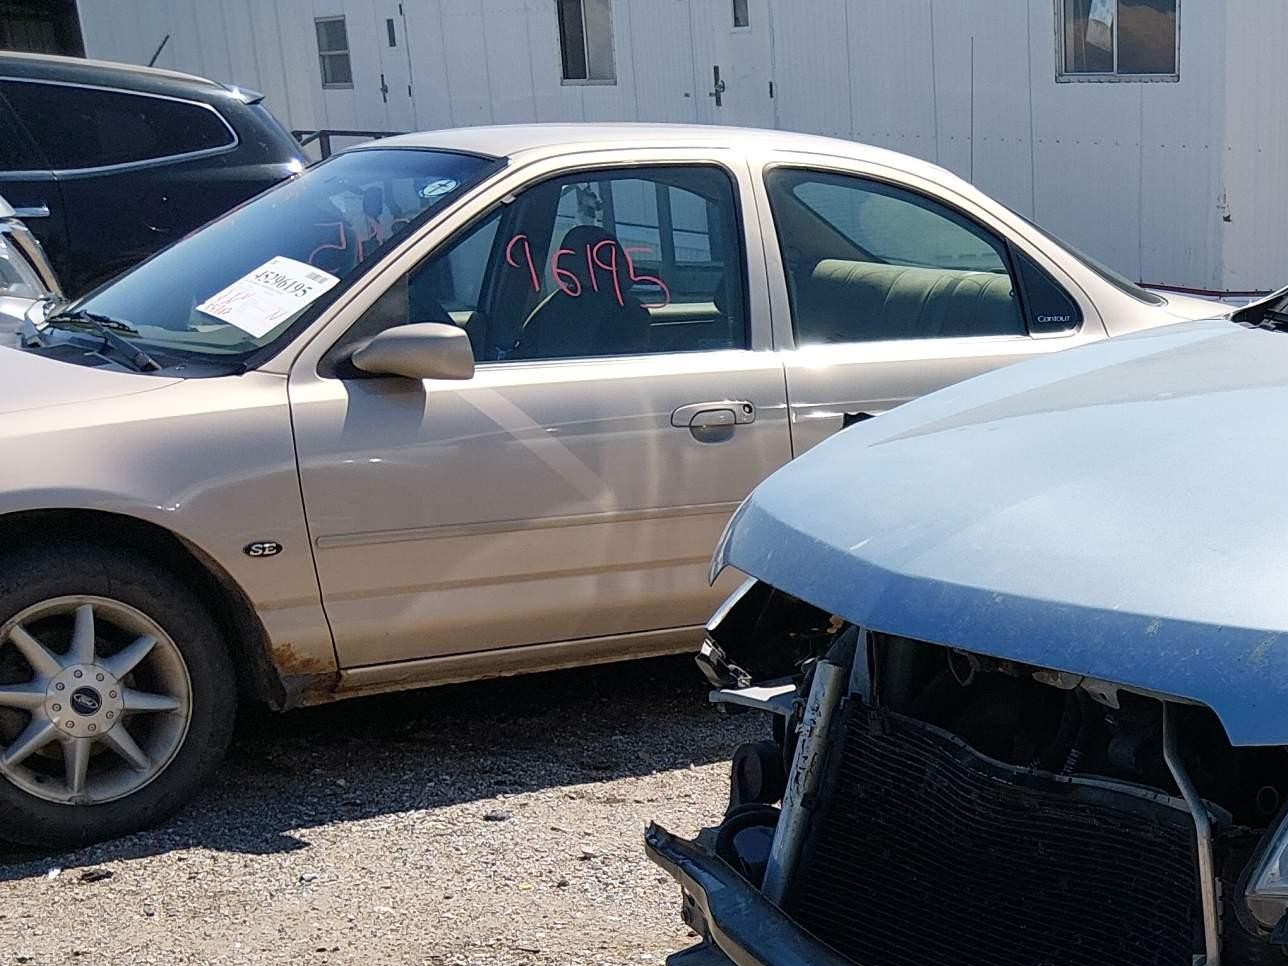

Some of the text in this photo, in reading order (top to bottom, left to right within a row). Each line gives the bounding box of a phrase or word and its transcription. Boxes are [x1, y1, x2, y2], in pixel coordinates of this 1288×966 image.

[506, 234, 670, 309] 96195
[254, 270, 313, 298] 45296195
[1037, 315, 1070, 323] Contour
[249, 543, 277, 556] SE
